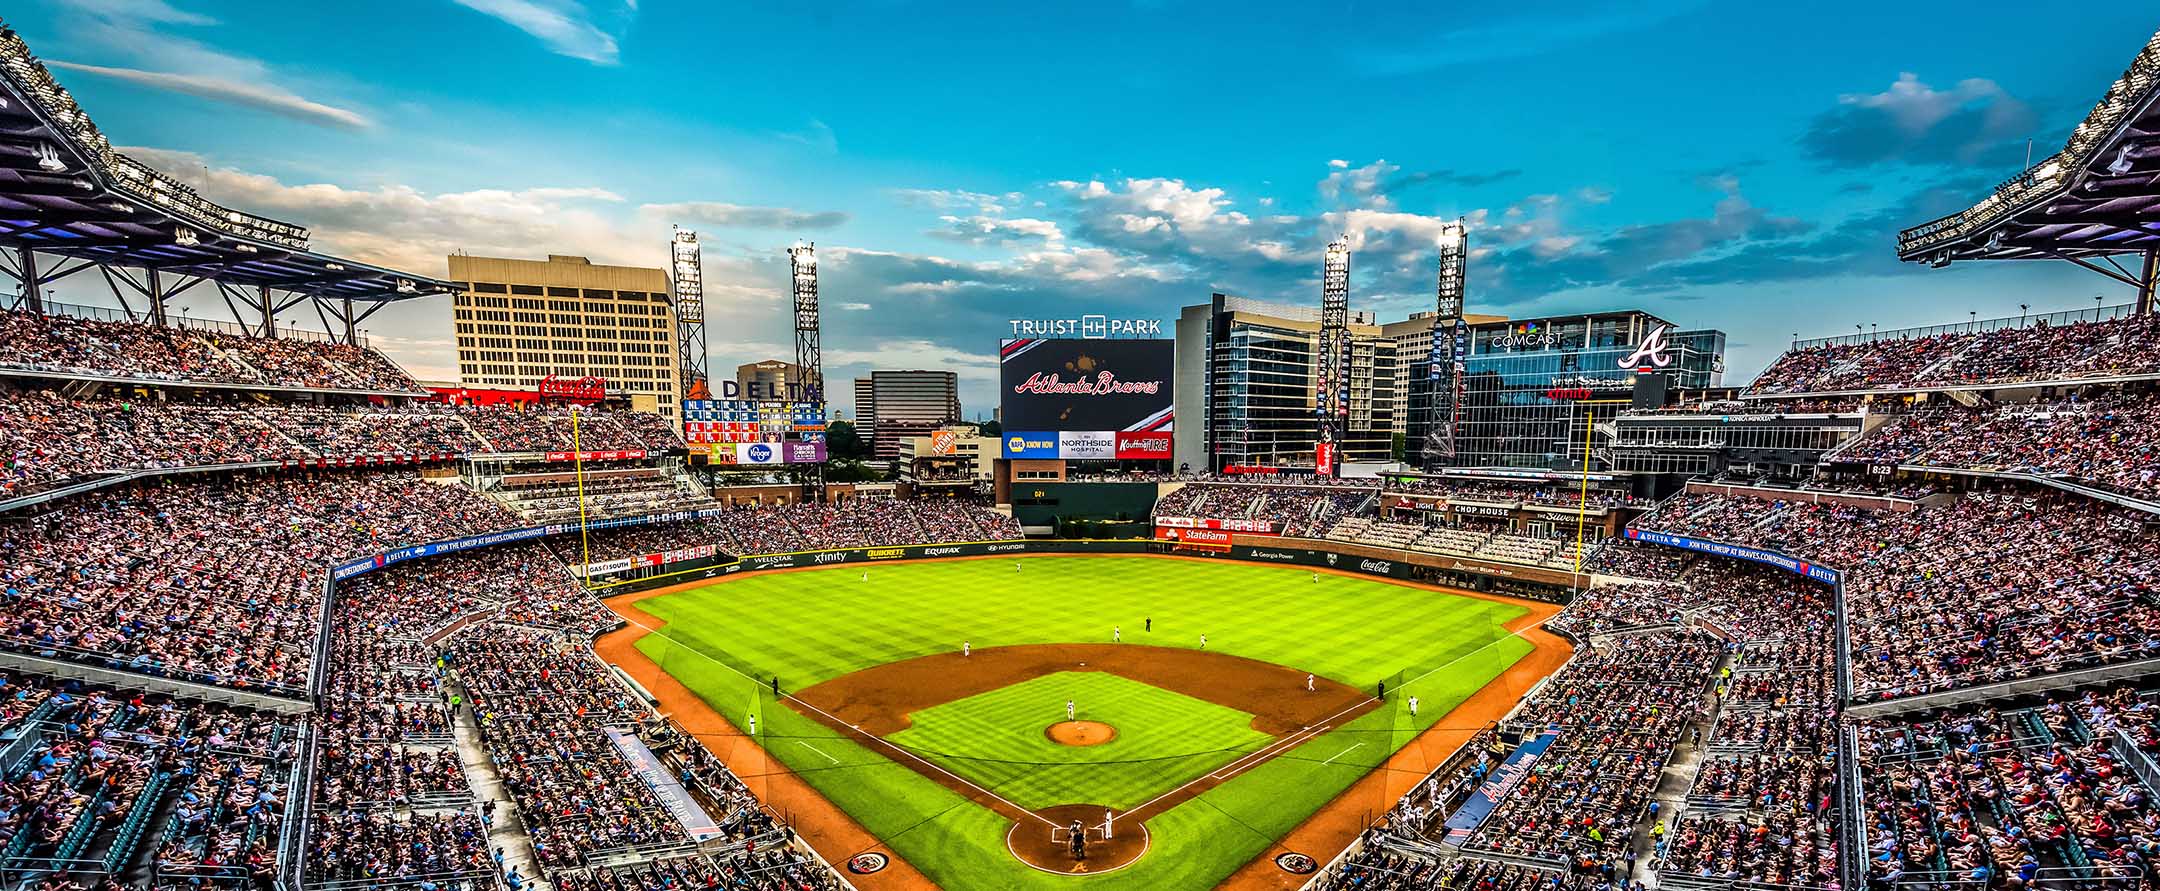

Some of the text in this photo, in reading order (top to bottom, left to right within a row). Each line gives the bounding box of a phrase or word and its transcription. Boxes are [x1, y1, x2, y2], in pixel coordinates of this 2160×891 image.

[1010, 320, 1160, 334] TRUIST PARK
[1492, 333, 1563, 348] COMCAST
[1014, 370, 1158, 395] Atlanta Braves
[723, 380, 820, 400] DELTA
[1547, 386, 1593, 400] xfinity
[688, 401, 699, 410] NL
[690, 423, 700, 432] AL
[933, 432, 953, 454] HOME
[1026, 440, 1041, 448] KNOW
[1042, 440, 1054, 448] HOW
[1143, 438, 1169, 451] TIRE
[750, 446, 771, 460] Kroger
[1872, 465, 1891, 475] 8:23
[1455, 505, 1509, 516] CHOP HOUSE
[1546, 512, 1575, 522] Silver
[436, 544, 448, 552] JOIN
[449, 542, 459, 550] THE
[460, 539, 477, 548] LINEUP
[478, 537, 485, 545] AT
[1645, 535, 1668, 544] DELTA
[867, 549, 904, 557] QUIKRETE
[924, 547, 960, 556] EQUIFAX
[1688, 541, 1700, 549] JOIN
[1701, 542, 1711, 551] THE
[1711, 544, 1730, 554] LINEUP
[390, 551, 411, 562] DELTA
[754, 555, 793, 563] WELLSTAR
[814, 552, 847, 564] xfinity
[1259, 552, 1278, 560] Georgia
[589, 561, 629, 573] GAS SOUTH
[1815, 569, 1836, 583] DELTA
